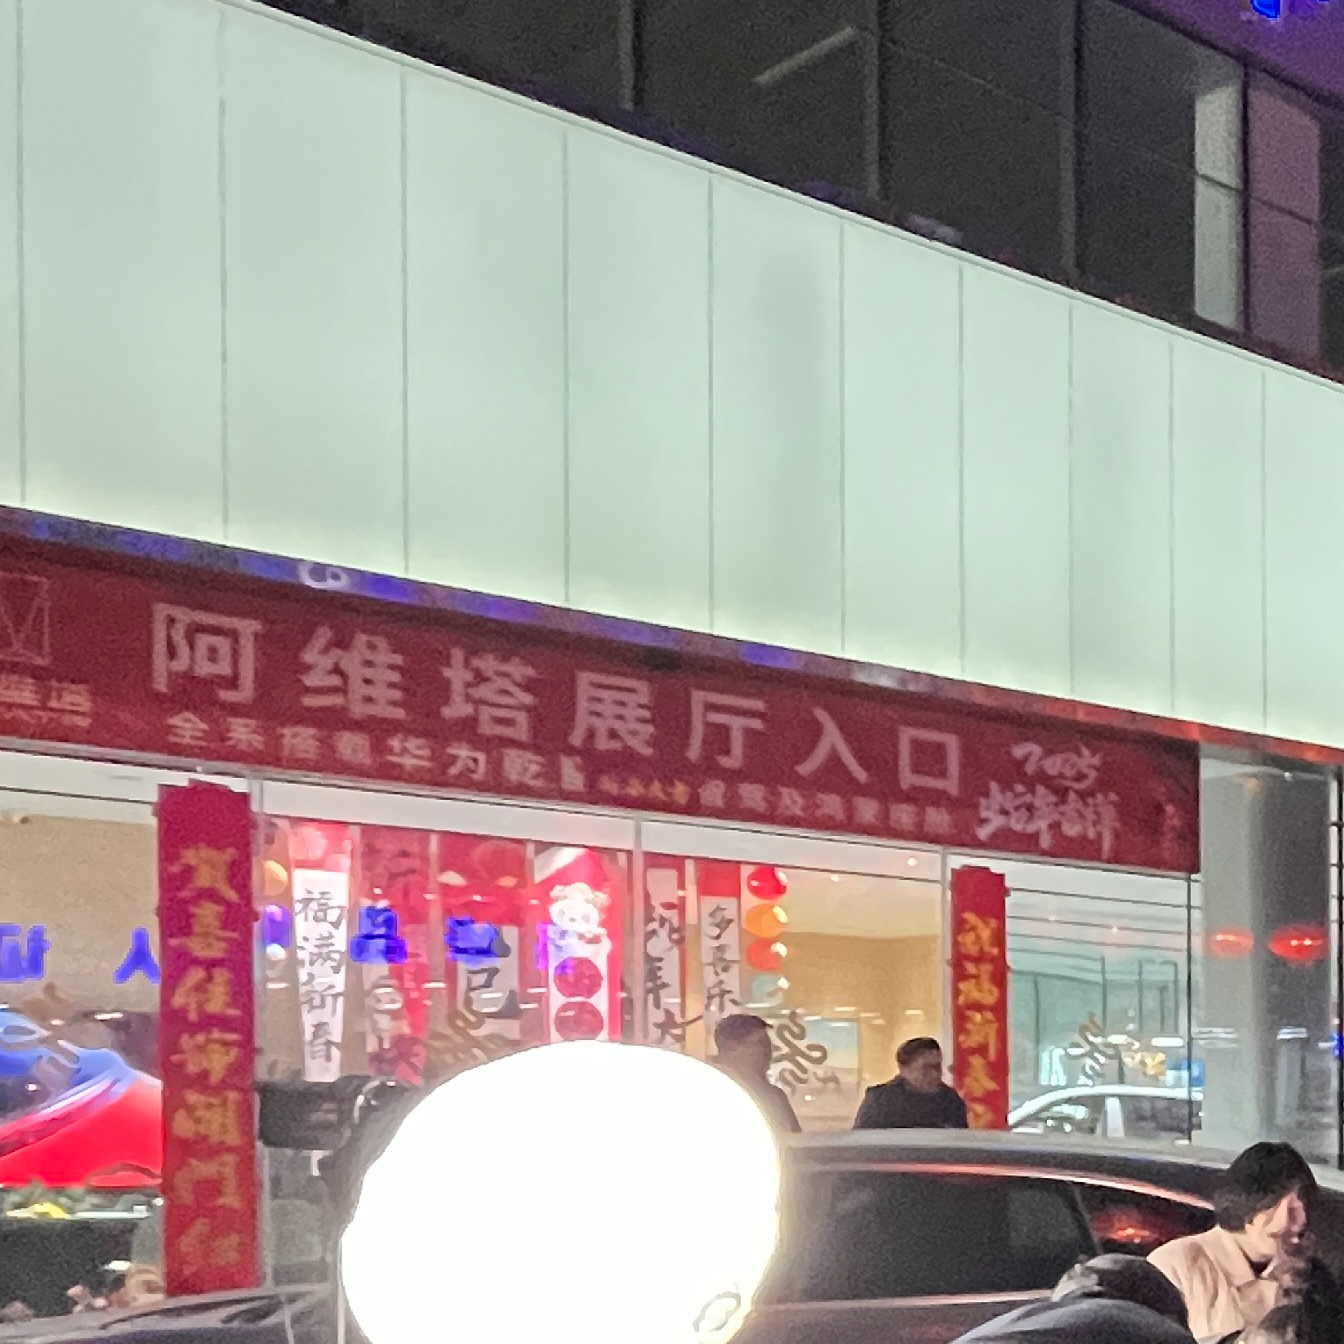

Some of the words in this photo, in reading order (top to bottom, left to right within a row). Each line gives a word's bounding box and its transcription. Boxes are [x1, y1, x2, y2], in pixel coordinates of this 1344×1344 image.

[151, 602, 962, 796] 阿维塔展厅入口
